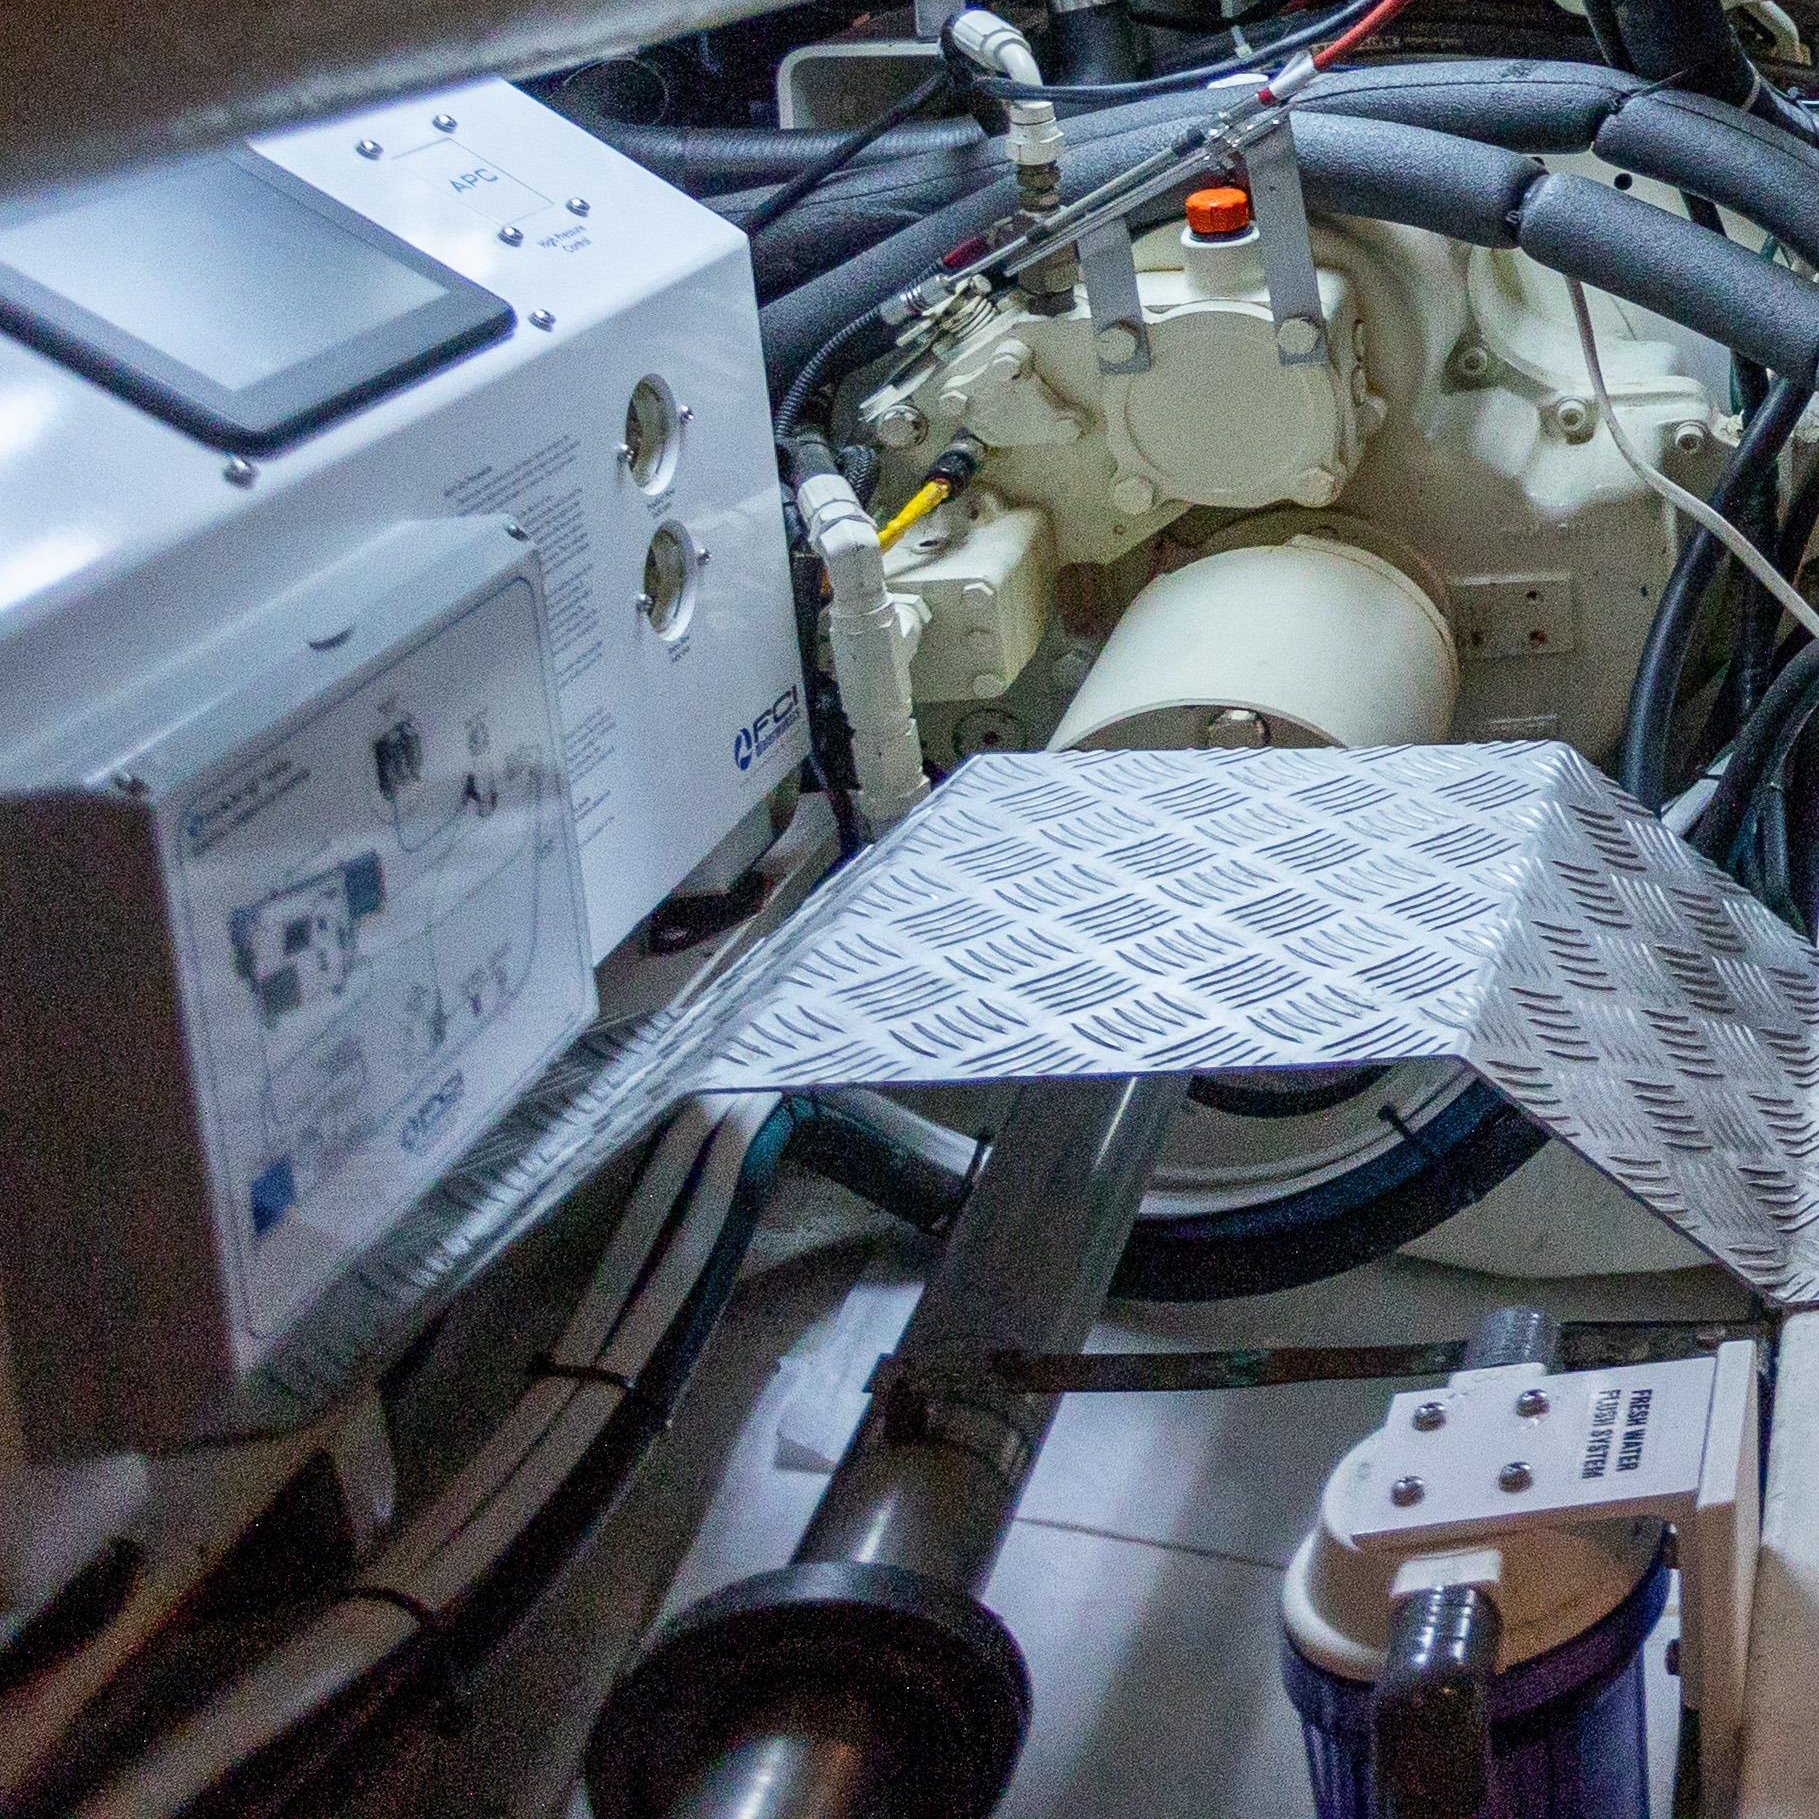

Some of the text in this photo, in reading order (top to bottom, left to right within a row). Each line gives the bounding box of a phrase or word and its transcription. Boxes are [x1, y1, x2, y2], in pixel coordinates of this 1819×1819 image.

[449, 168, 499, 193] APC
[753, 683, 799, 743] FCI
[1582, 1389, 1621, 1479] FLUSH SYSTEM
[1617, 1389, 1652, 1472] FRESH WATER
